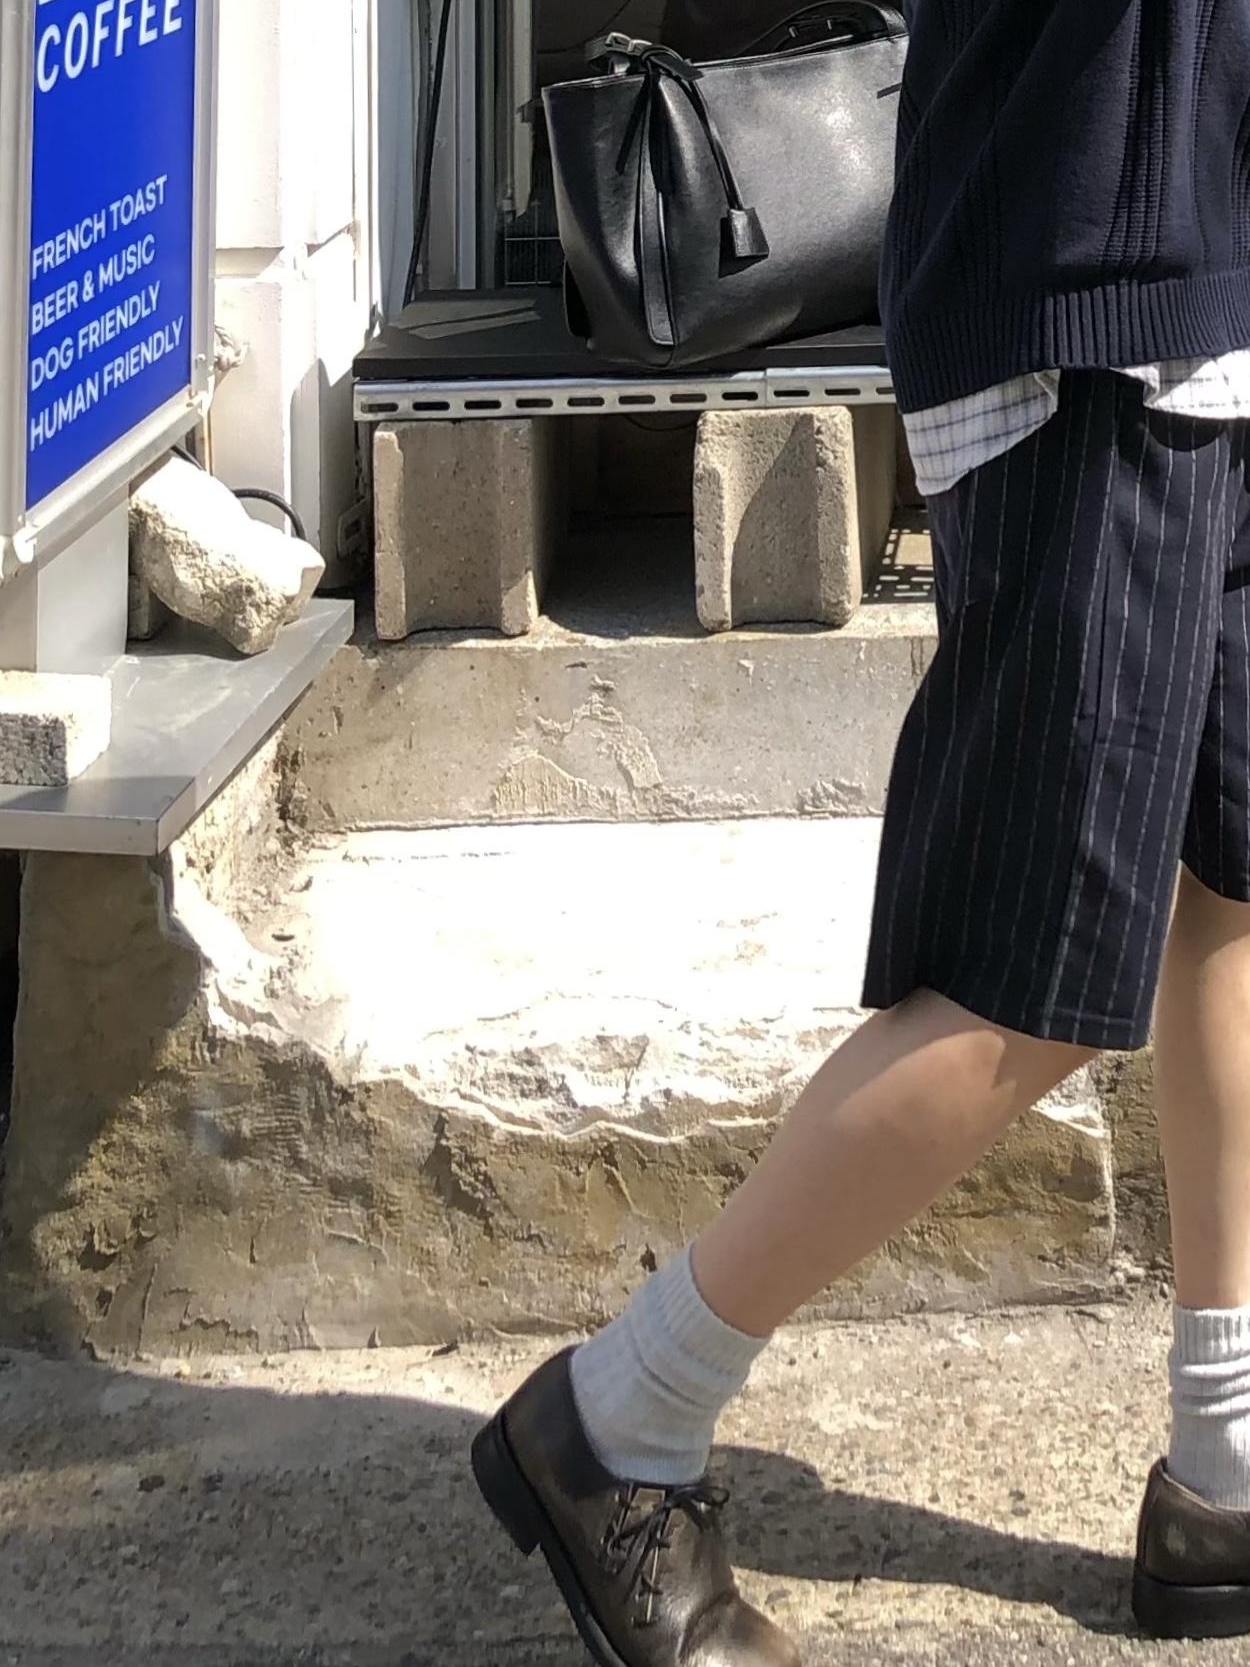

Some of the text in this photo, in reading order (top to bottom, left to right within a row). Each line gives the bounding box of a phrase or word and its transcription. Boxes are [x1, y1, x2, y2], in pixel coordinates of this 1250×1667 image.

[32, 174, 168, 280] FRENCH TOAST
[31, 234, 156, 336] BEER & MUSIC
[31, 280, 160, 392] DOG FRIENDLY
[30, 315, 184, 452] HUMAN FRIENDLY
